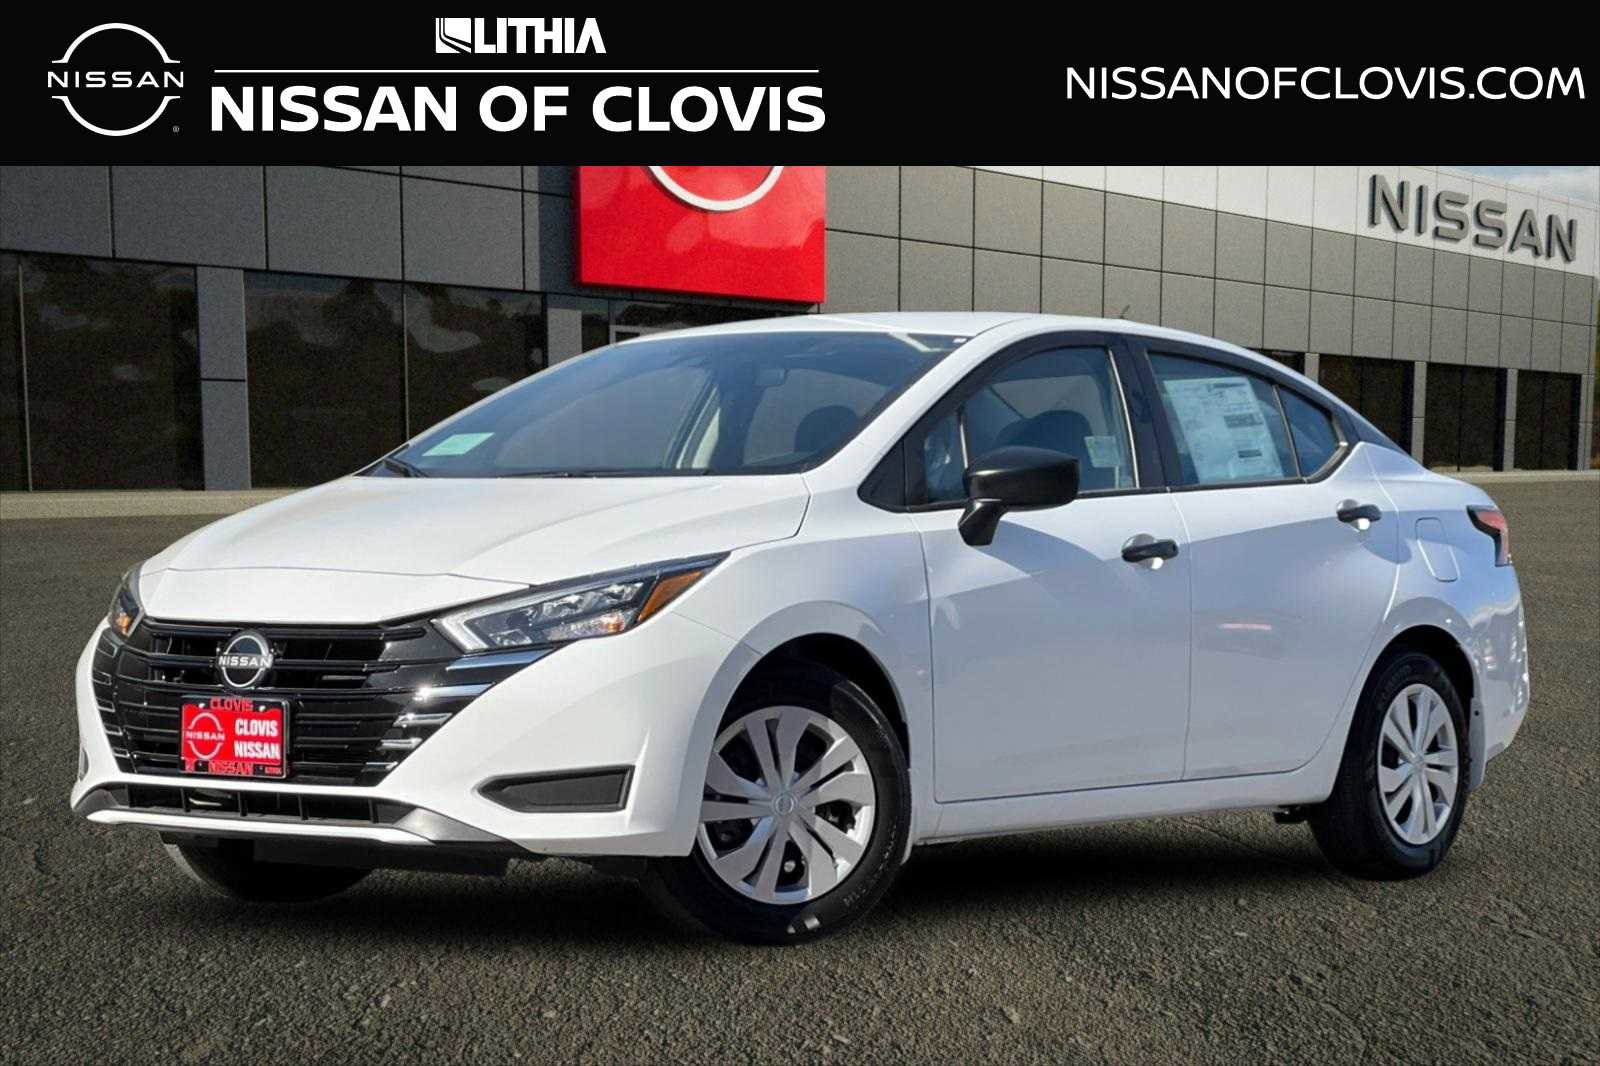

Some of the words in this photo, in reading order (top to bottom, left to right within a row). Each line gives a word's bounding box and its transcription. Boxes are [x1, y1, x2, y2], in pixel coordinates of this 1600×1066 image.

[1368, 174, 1577, 262] NISSAN
[218, 655, 273, 668] NISSAN
[210, 697, 253, 711] CLOVIS
[235, 719, 278, 737] CLOVIS
[185, 731, 225, 741] NISSAN
[234, 740, 281, 759] NISSAN
[208, 761, 254, 775] NISSAN
